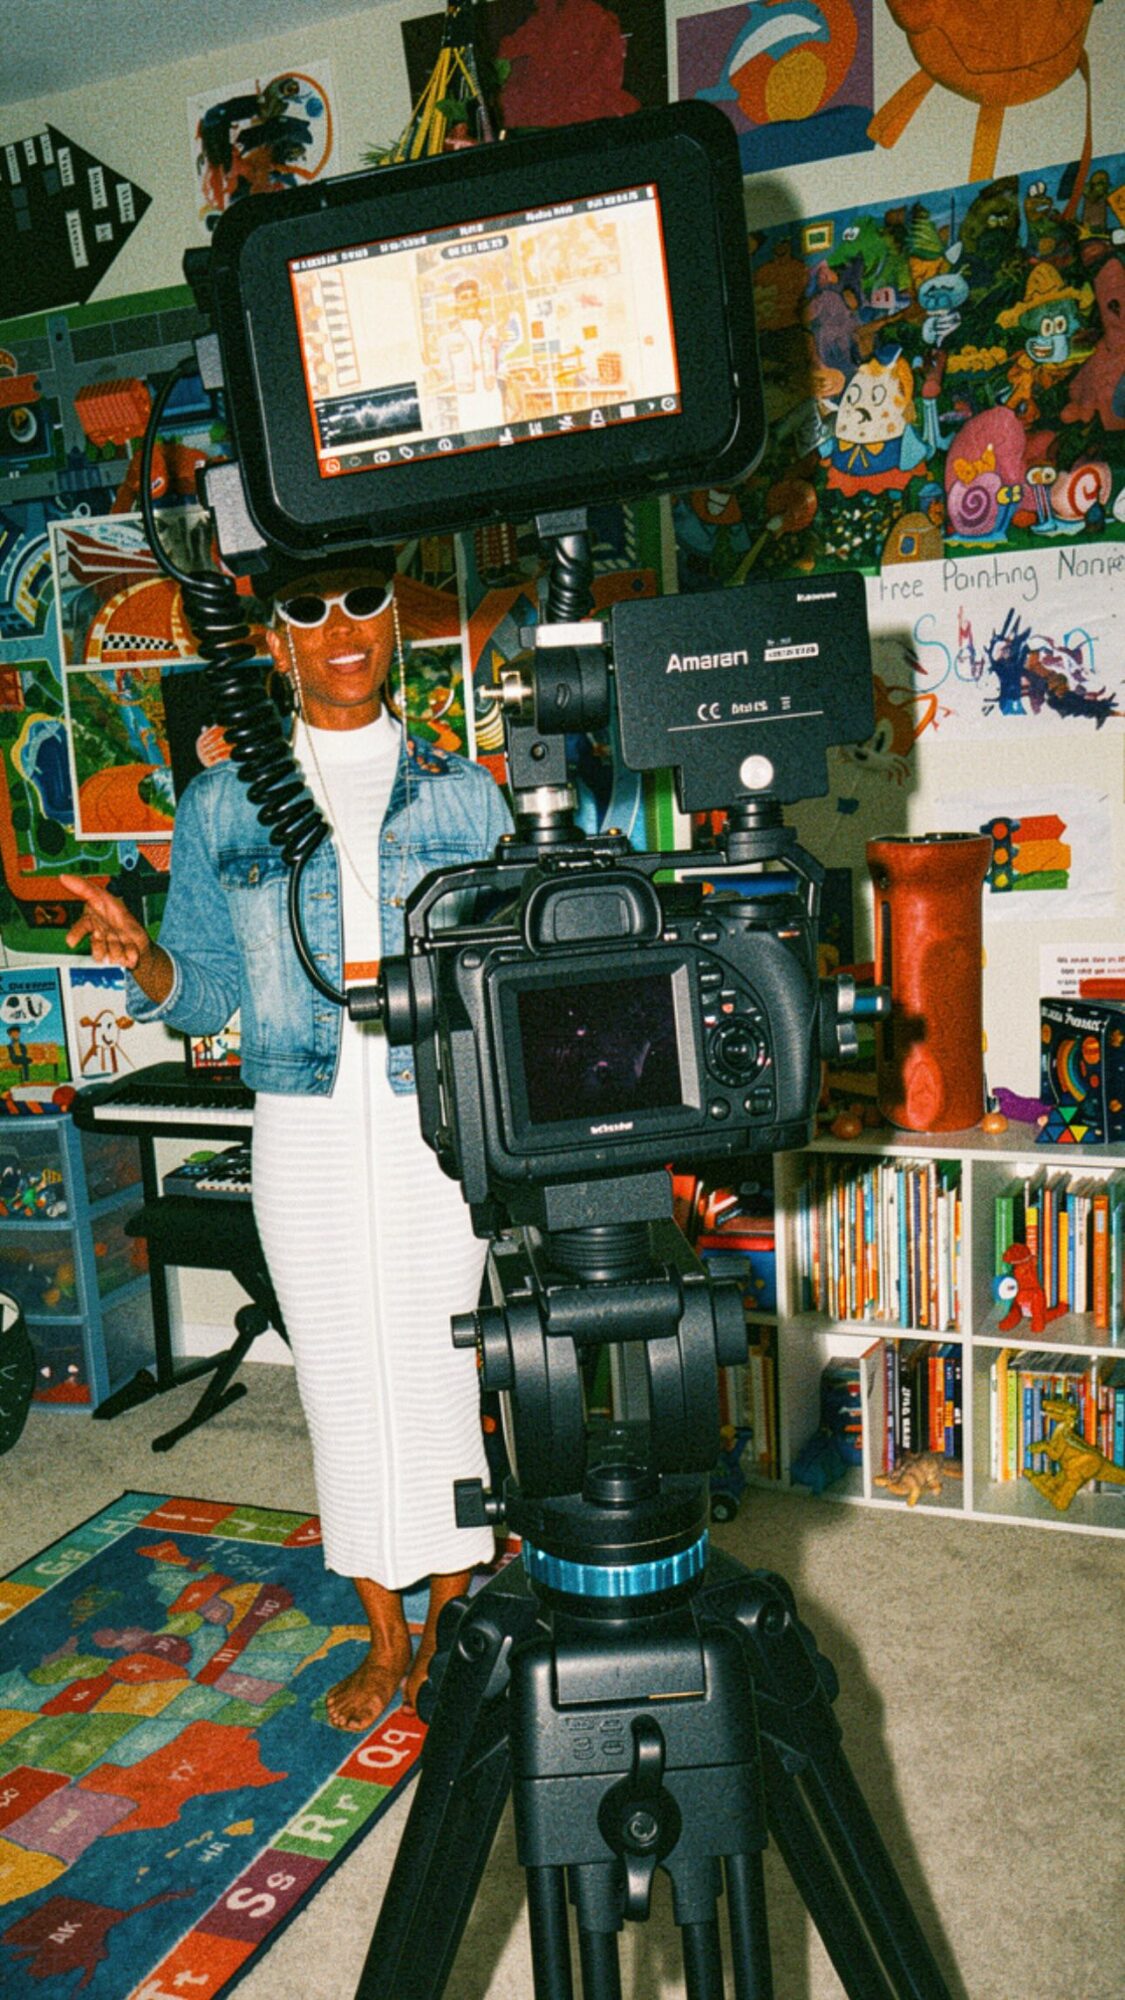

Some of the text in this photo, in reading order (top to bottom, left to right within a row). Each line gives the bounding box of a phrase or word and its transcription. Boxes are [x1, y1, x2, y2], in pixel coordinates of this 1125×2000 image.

[665, 649, 749, 674] Amaran
[356, 1728, 422, 1769] Qq
[287, 1793, 361, 1844] Rr
[226, 1871, 297, 1918] Ss
[48, 1919, 83, 1945] AK
